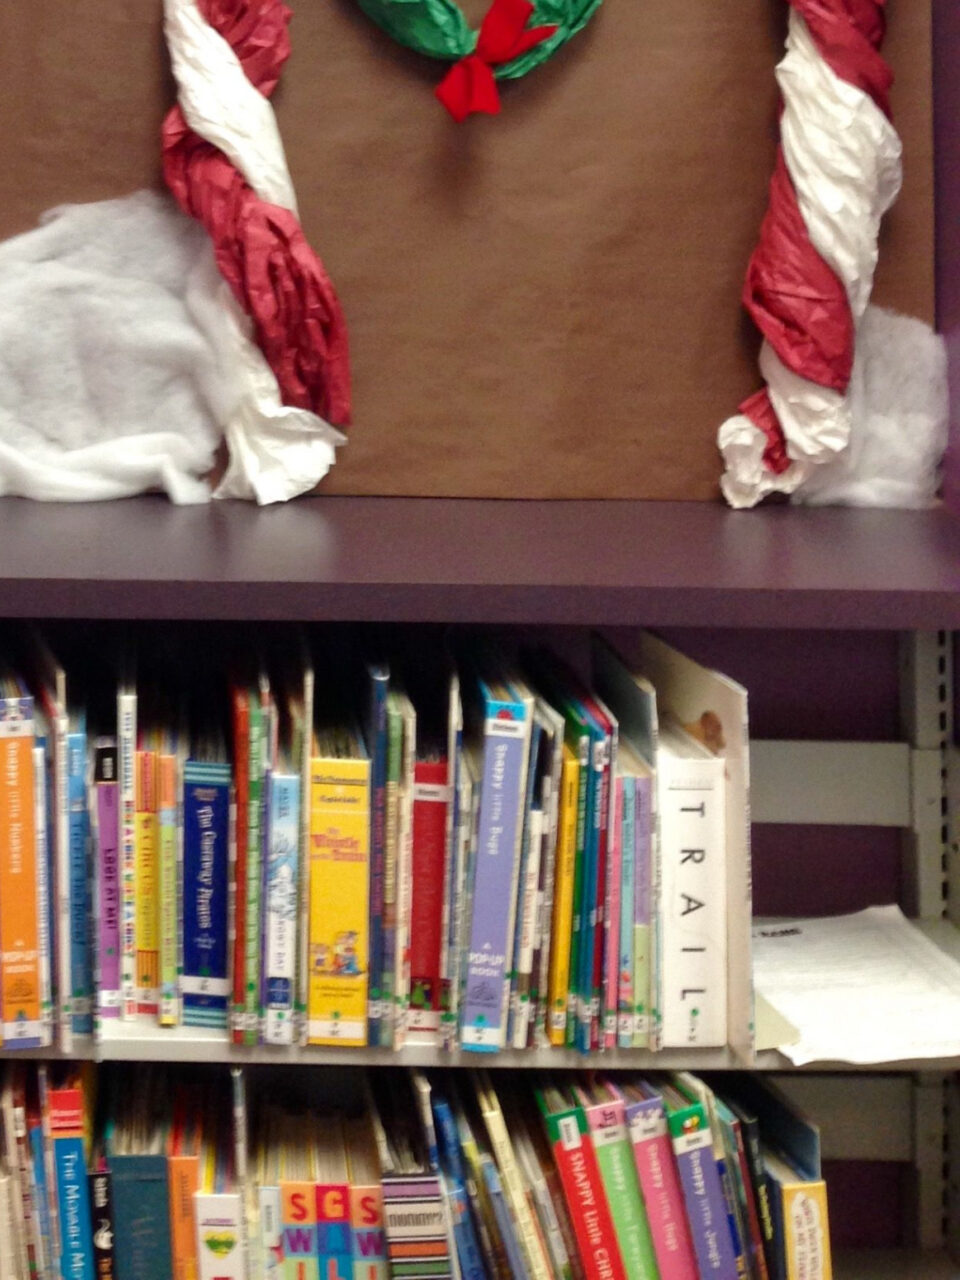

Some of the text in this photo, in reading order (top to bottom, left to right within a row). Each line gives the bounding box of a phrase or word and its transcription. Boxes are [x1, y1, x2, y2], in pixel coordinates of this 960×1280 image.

[7, 741, 22, 786] Snappy
[492, 744, 507, 790] Snappy
[198, 806, 213, 828] The
[8, 823, 23, 874] Numbers
[487, 826, 503, 855] Bugs
[198, 888, 215, 929] Pirates
[679, 801, 706, 1003] TRAIL
[62, 1151, 80, 1180] THE
[570, 1152, 594, 1206] SNAPPY
[583, 1211, 602, 1245] Little
[689, 1151, 708, 1195] Snappy
[704, 1230, 721, 1269] Jungle
